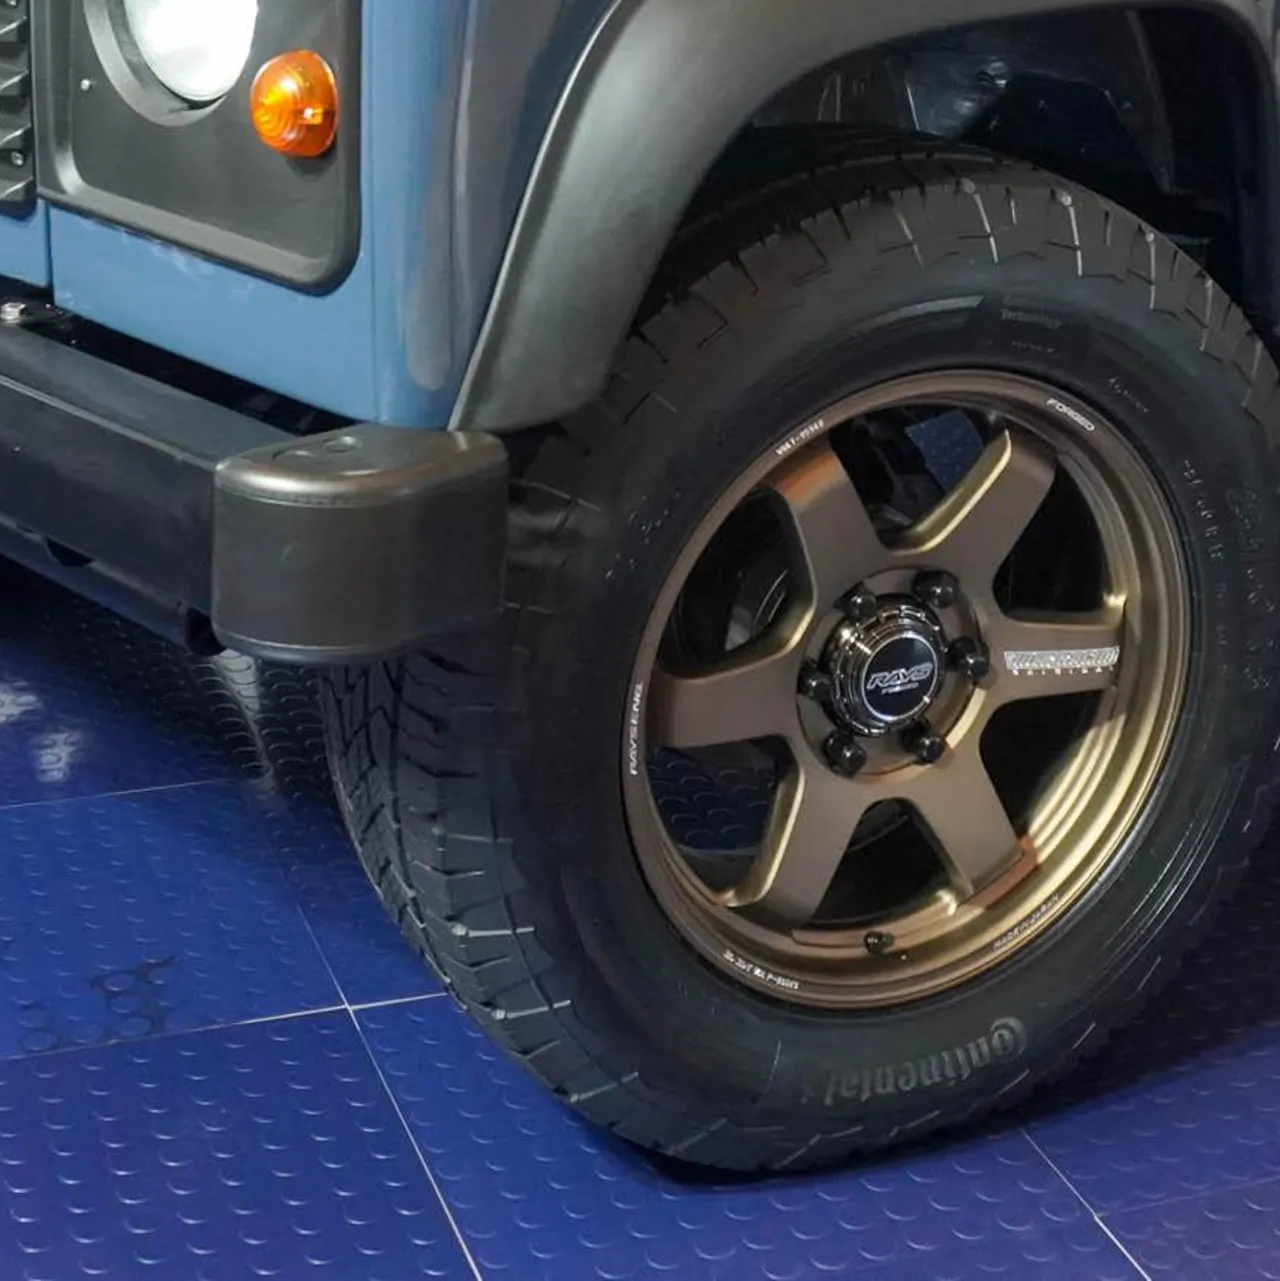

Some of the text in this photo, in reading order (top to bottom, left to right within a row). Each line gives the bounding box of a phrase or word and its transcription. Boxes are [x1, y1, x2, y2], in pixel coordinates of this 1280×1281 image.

[1046, 398, 1095, 431] FORGED
[866, 661, 933, 690] RAYS
[823, 1017, 1027, 1106] Continental
